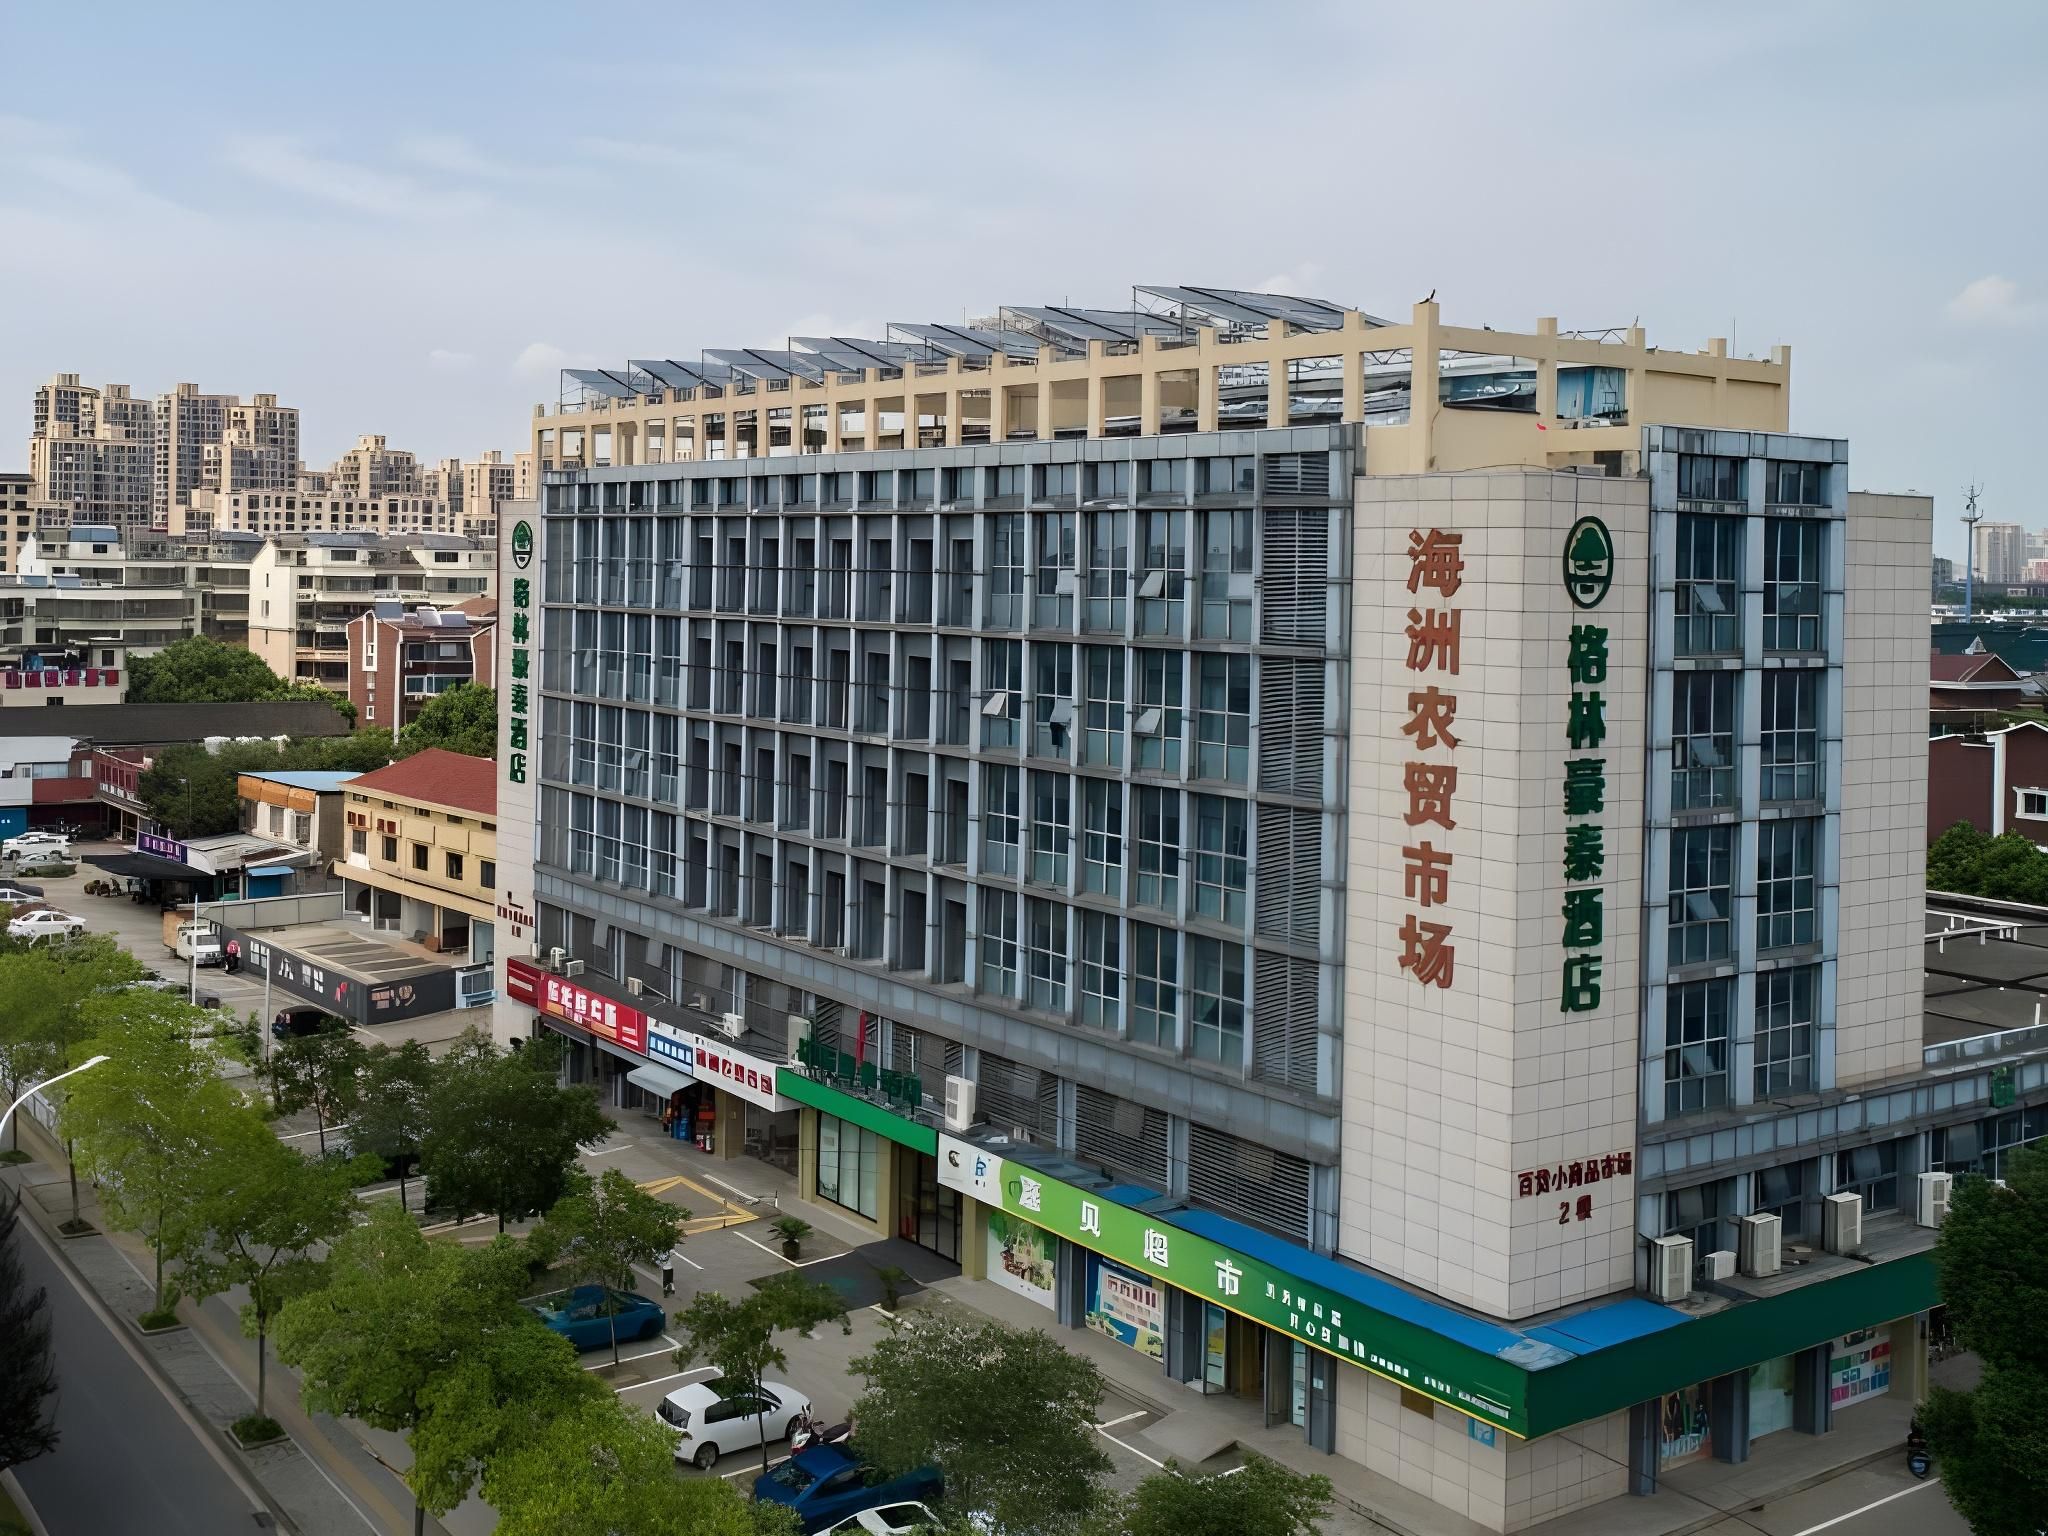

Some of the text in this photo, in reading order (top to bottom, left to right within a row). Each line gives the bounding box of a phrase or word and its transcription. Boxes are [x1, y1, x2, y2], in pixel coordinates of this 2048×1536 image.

[1399, 528, 1464, 989] 海洲农贸市场
[1560, 625, 1609, 1013] 格林豪泰酒店
